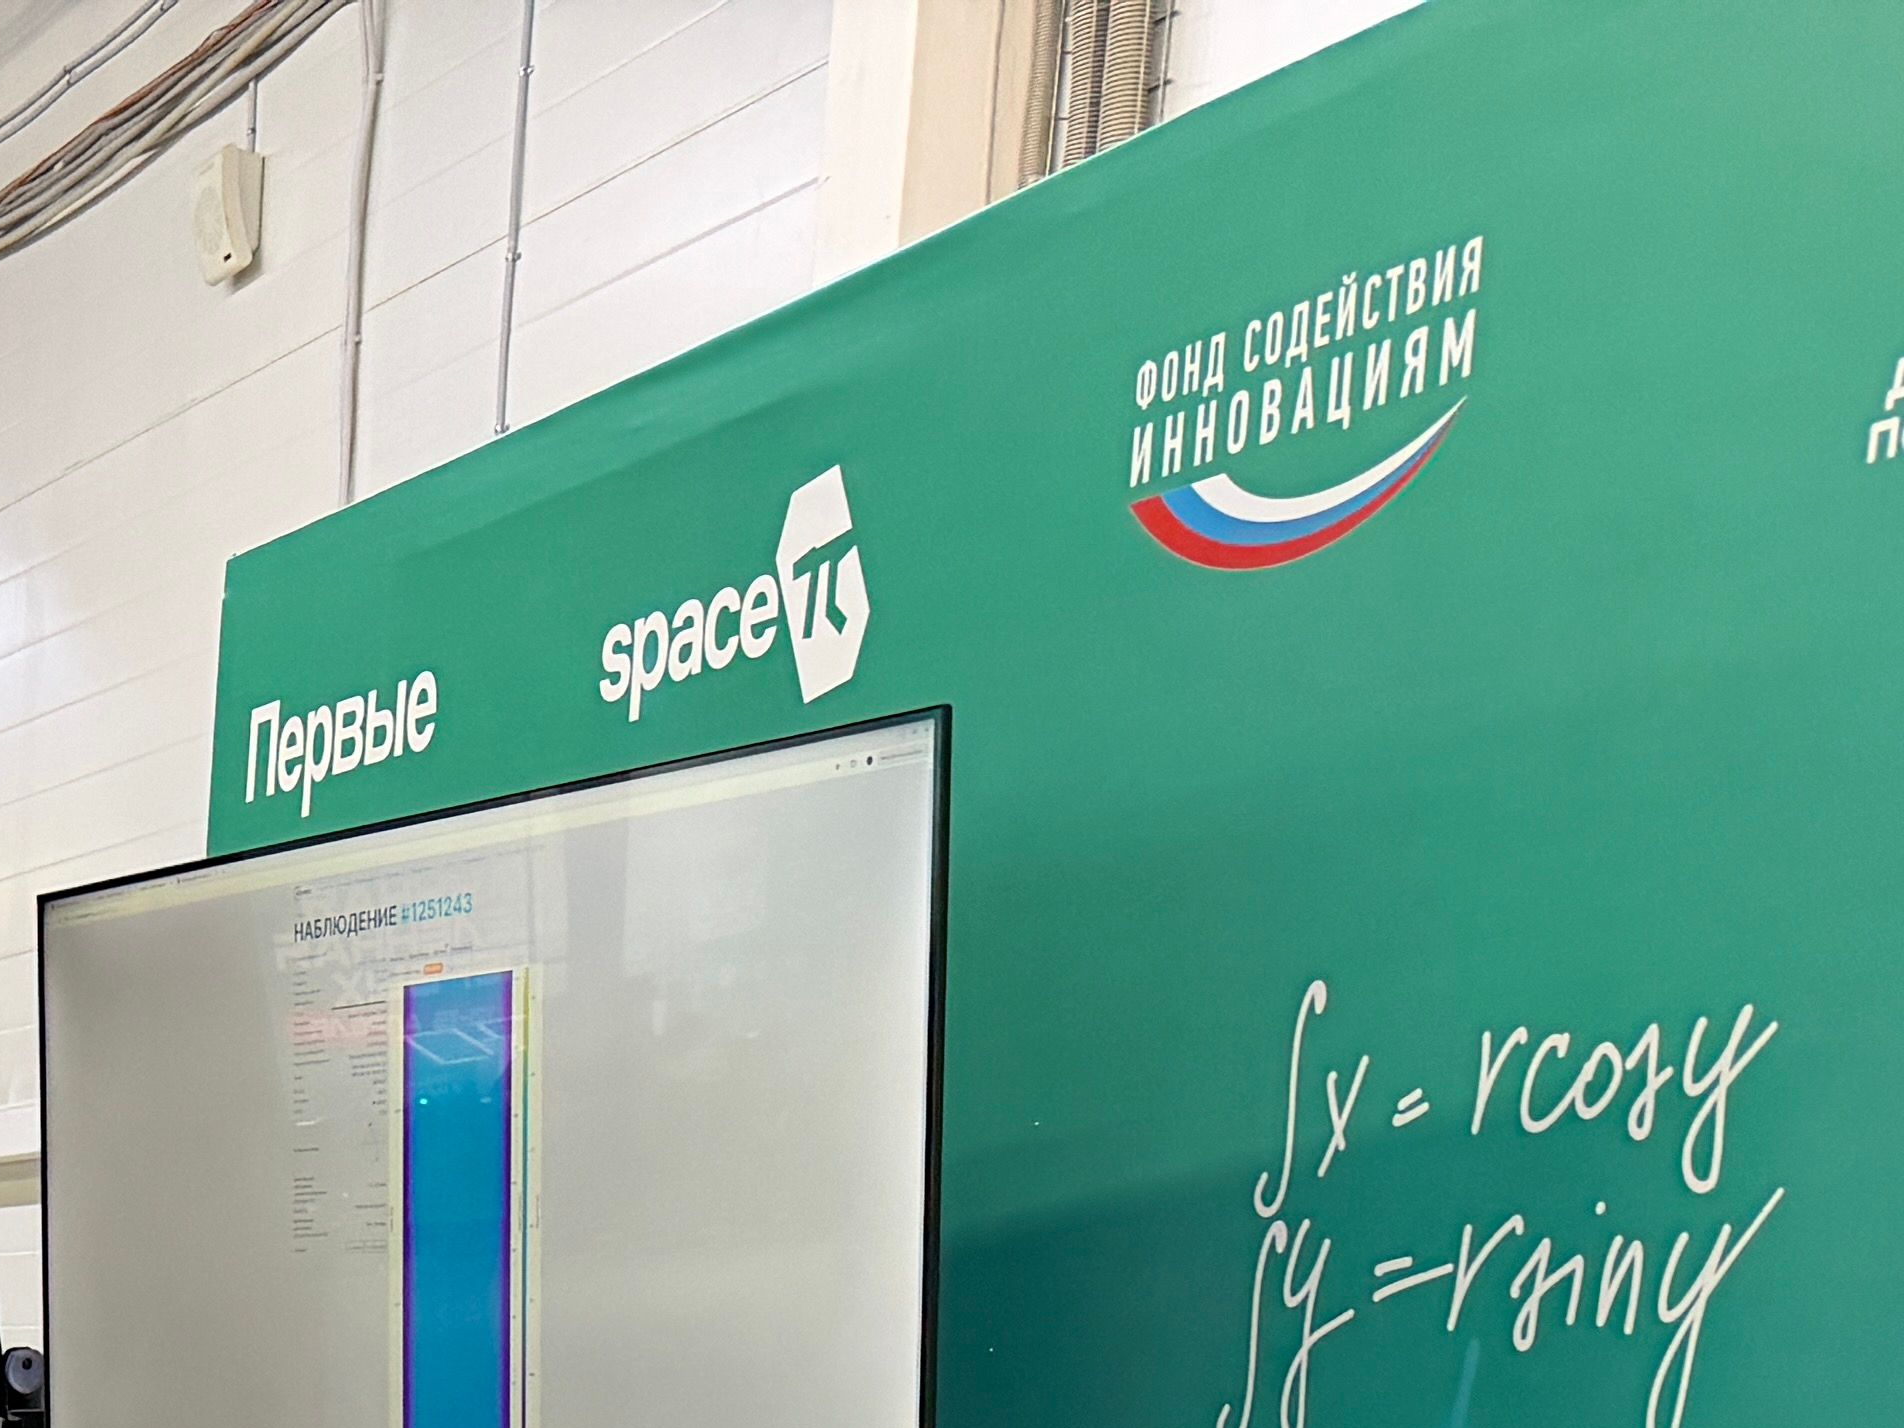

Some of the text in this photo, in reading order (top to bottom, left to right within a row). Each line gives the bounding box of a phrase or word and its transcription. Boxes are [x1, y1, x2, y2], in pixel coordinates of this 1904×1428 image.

[1128, 306, 1479, 488] ИННОВАЦИЯМ
[1133, 234, 1484, 412] ФОНД СОДЕЙСТВИЯ
[243, 667, 439, 818] Первые
[294, 892, 473, 942] НАБЛЮДЕНИЕ #1251243
